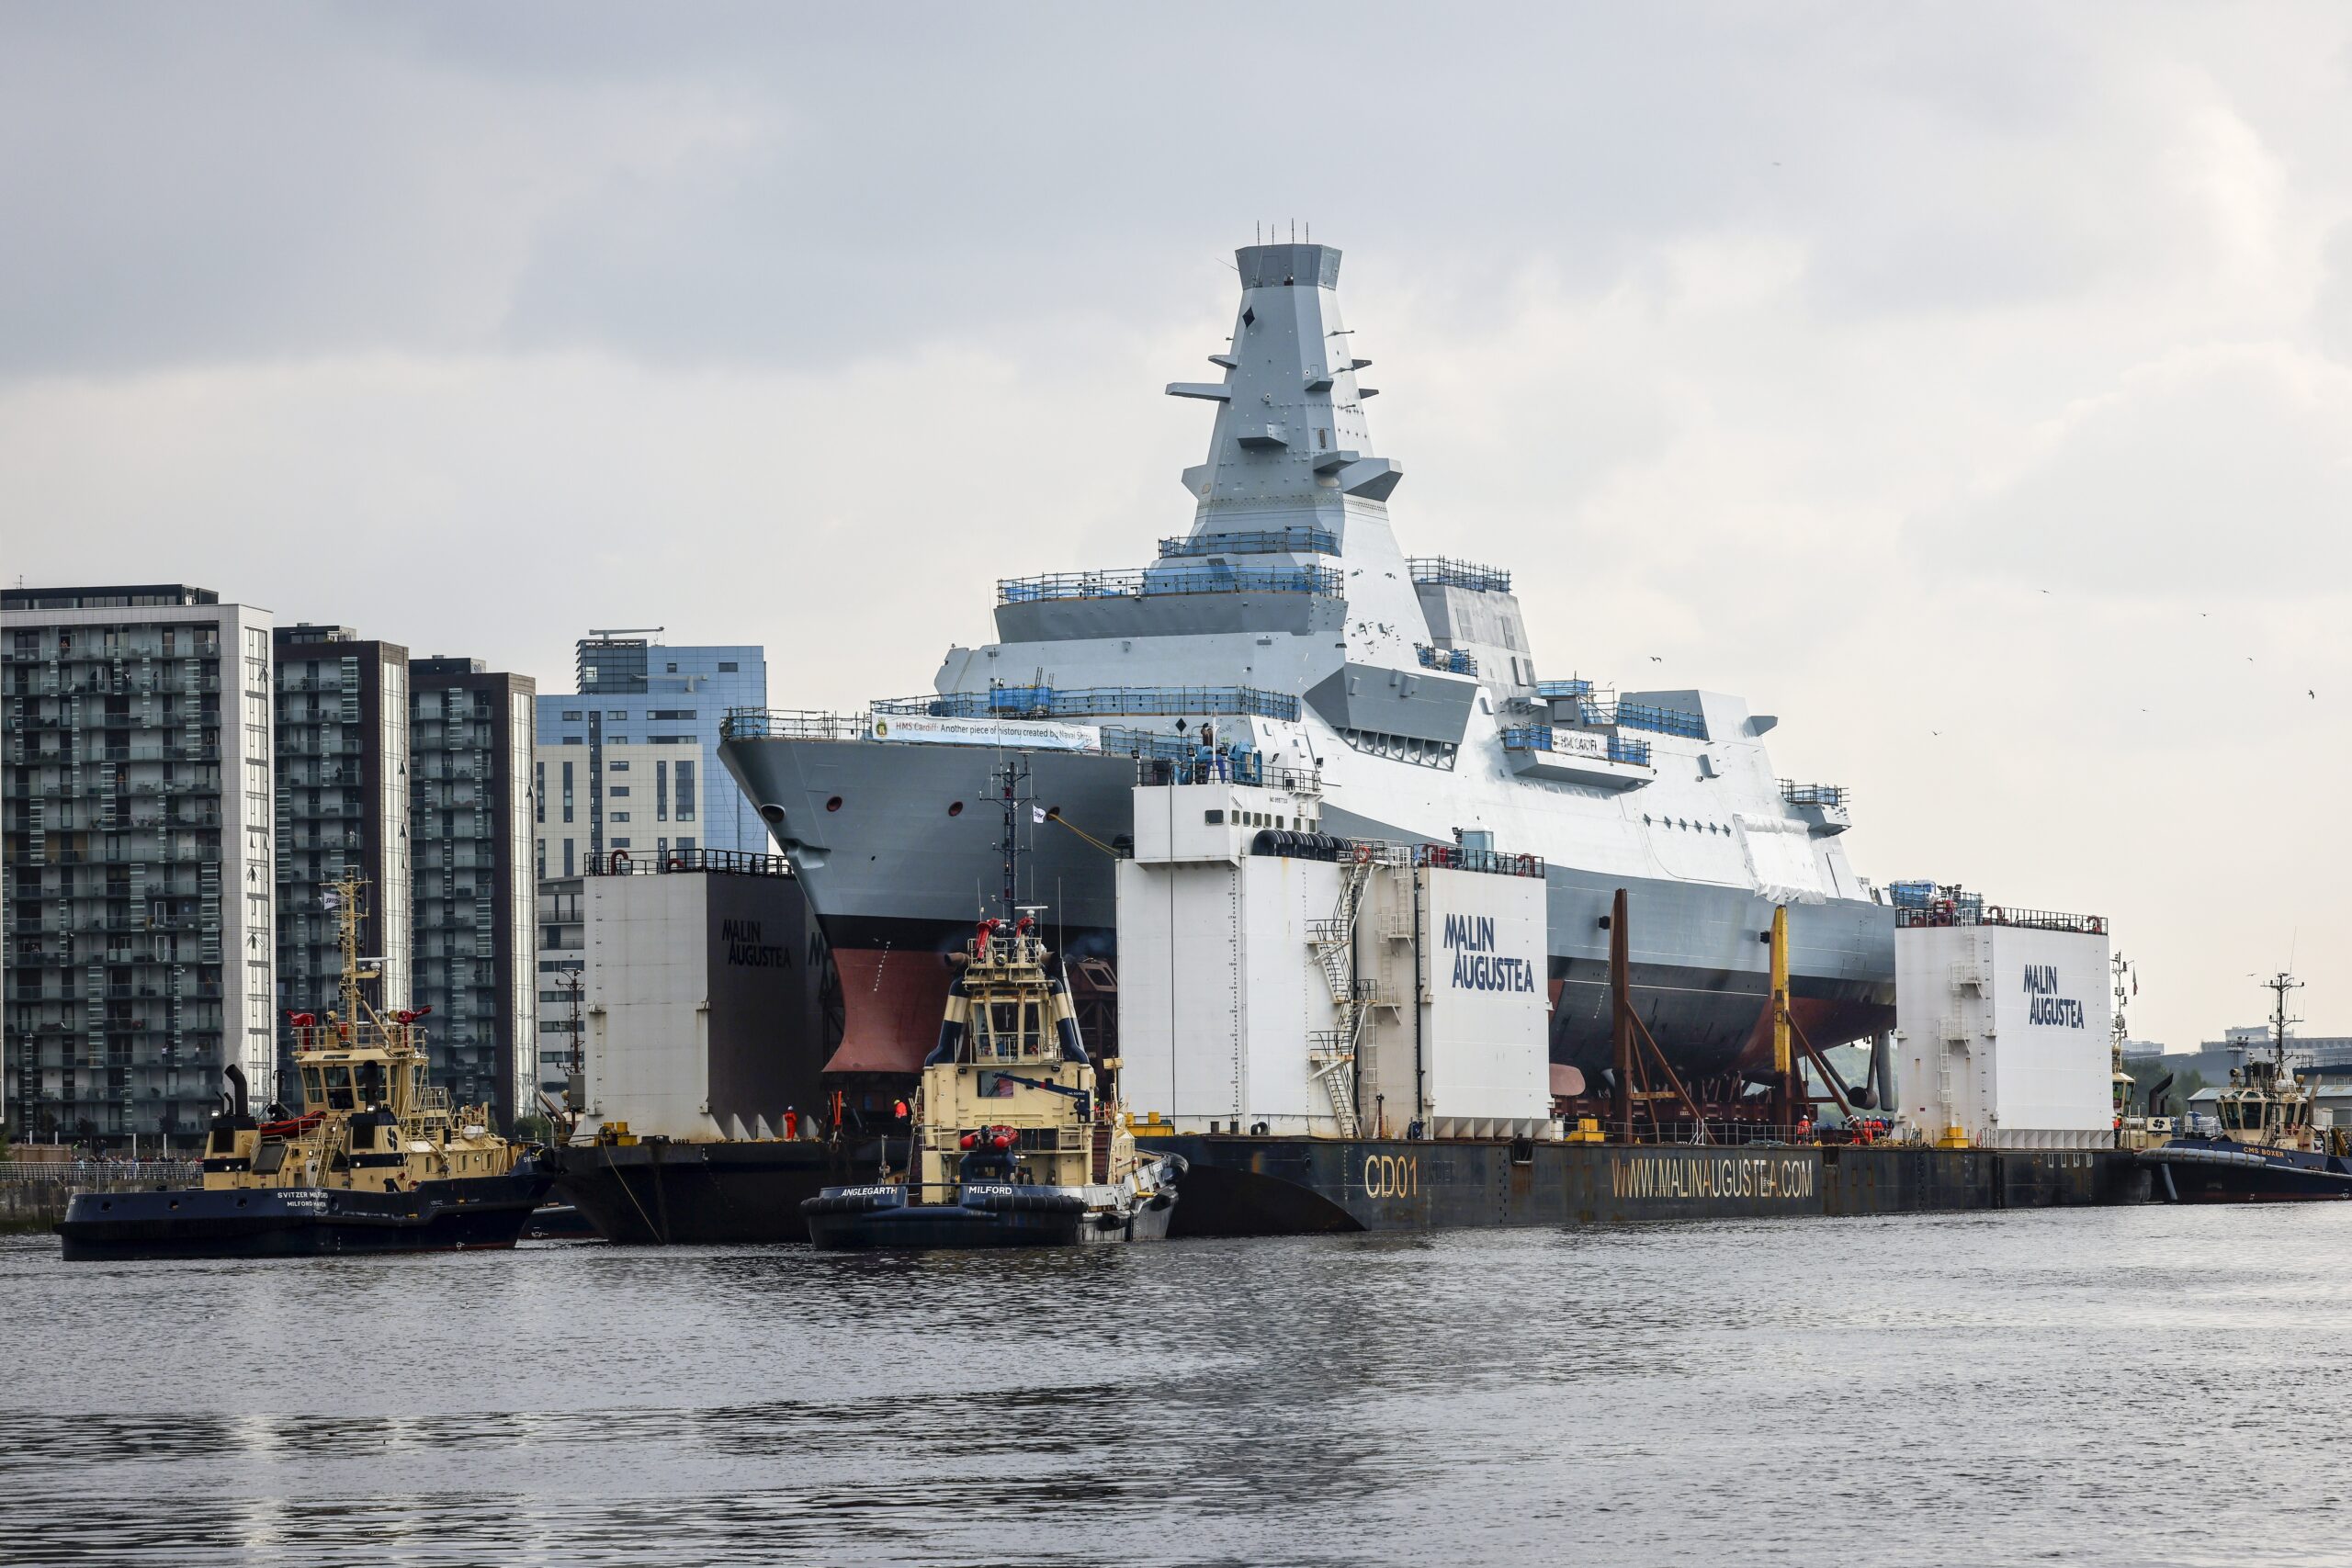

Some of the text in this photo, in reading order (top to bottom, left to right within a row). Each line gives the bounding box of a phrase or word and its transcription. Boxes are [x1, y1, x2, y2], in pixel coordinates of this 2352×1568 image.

[896, 721, 912, 731] HMS
[914, 722, 938, 732] Cardiff:
[940, 724, 968, 734] Another
[970, 726, 989, 735] piece
[989, 725, 997, 735] of
[1023, 728, 1048, 738] created
[1049, 729, 1058, 741] by
[721, 919, 761, 943] MALIN
[1443, 913, 1495, 953] MALIN
[728, 944, 792, 969] AUGUSTEA
[1452, 953, 1535, 993] AUGUSTEA
[2023, 964, 2058, 995] MALIN
[2029, 996, 2085, 1030] AUGUSTEA
[2261, 1148, 2285, 1157] BOXER
[968, 1186, 1012, 1195] MILFORD
[1364, 1155, 1418, 1199] CD01
[1611, 1158, 1813, 1198] WWW.MALINAUGUSTEA.COM
[841, 1187, 898, 1197] ANGLEGARTH
